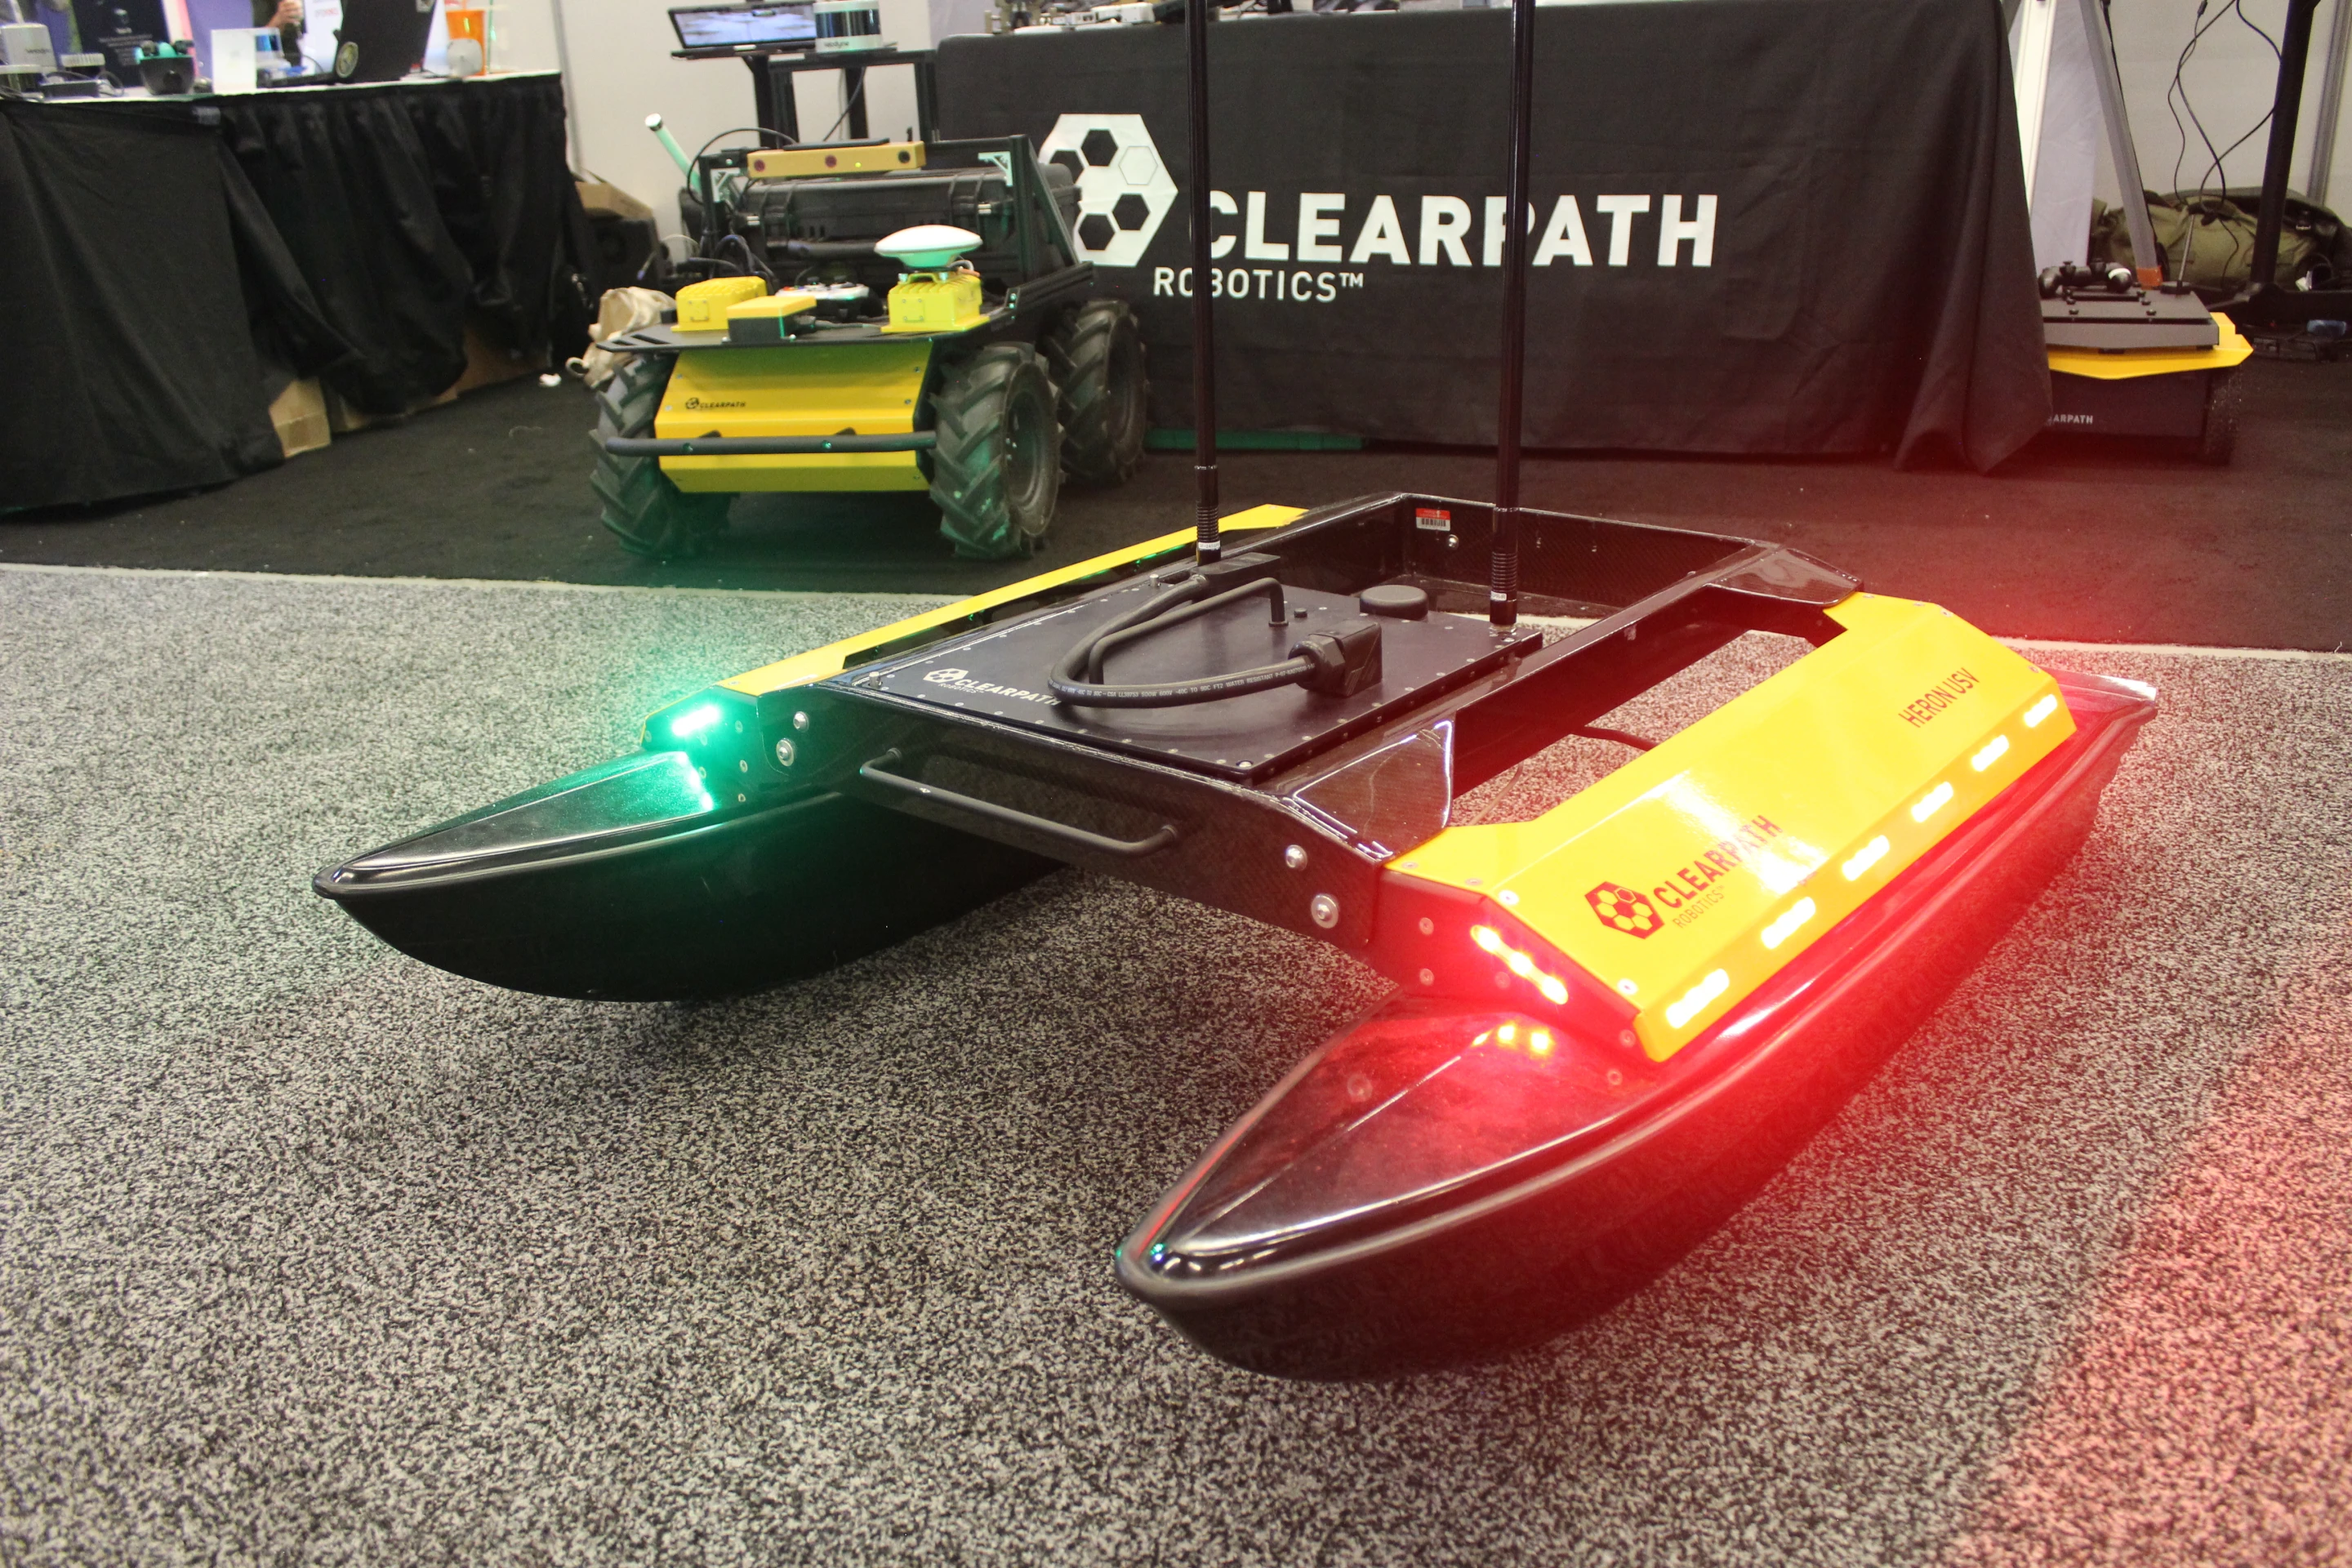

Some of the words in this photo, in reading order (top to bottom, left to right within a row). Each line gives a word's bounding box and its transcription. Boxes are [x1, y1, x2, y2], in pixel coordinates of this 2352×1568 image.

[1189, 190, 1718, 267] CLEARPATH
[2049, 414, 2093, 424] ARPATH
[955, 679, 1062, 706] CLEARPATH
[1225, 679, 1245, 688] WATER
[1246, 673, 1273, 684] RESISTANT
[1898, 685, 1958, 728] HERON
[1942, 667, 1980, 694] USV
[1653, 815, 1784, 909] CLEARPATH
